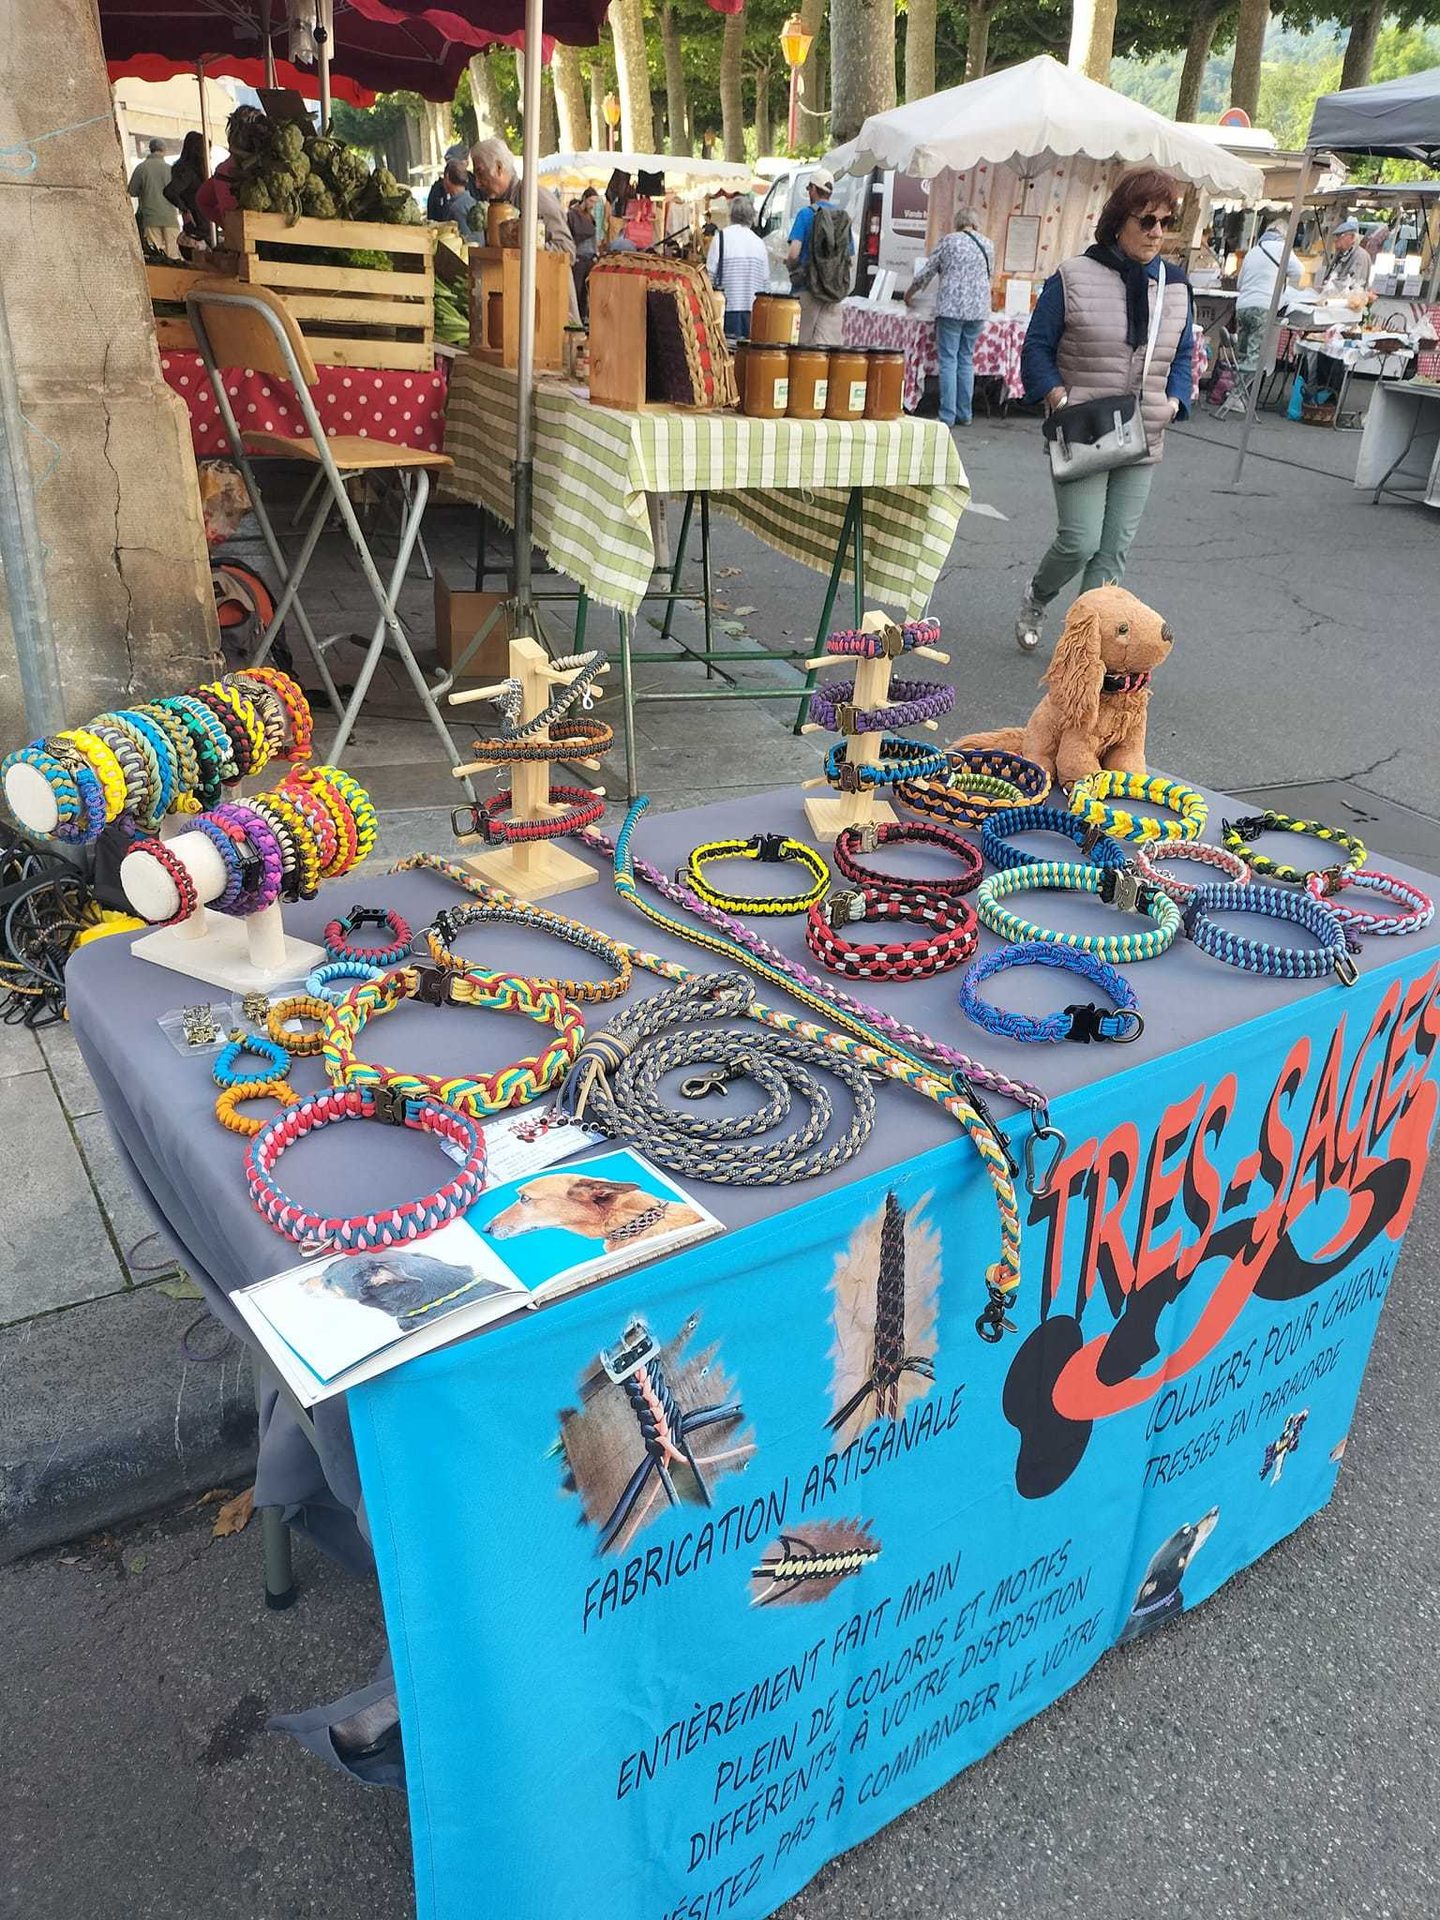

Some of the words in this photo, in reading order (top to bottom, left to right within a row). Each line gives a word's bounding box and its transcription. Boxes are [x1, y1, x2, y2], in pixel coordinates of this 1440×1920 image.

[1142, 1417, 1224, 1489] TRESSÉS
[1227, 1400, 1254, 1446] EN
[1256, 1339, 1344, 1428] PARACORDE
[1145, 1338, 1257, 1442] COLLIERS
[1259, 1301, 1319, 1375] POUR
[1322, 1251, 1393, 1329] CHIENS
[582, 1476, 789, 1635] FABRICATION
[801, 1384, 966, 1513] ARTISANALE
[616, 1639, 826, 1801] ENTIÈREMENT
[832, 1598, 891, 1667] FAIT
[897, 1550, 962, 1628] MAIN
[687, 1732, 840, 1874] DIFFÉRENTS
[849, 1709, 870, 1754] À
[882, 1657, 956, 1738] VOTRE
[959, 1567, 1092, 1679] DISPOSITION
[714, 1722, 799, 1805] PLEIN
[807, 1690, 839, 1747] DE
[846, 1617, 948, 1710] COLORIS
[954, 1591, 985, 1641] ET
[988, 1539, 1072, 1616] MOTIFS
[773, 1801, 820, 1871] PAS
[826, 1776, 845, 1822] À
[858, 1682, 1000, 1806] COMMANDER
[1008, 1659, 1036, 1702] LE
[1042, 1608, 1104, 1682] VÔTRE
